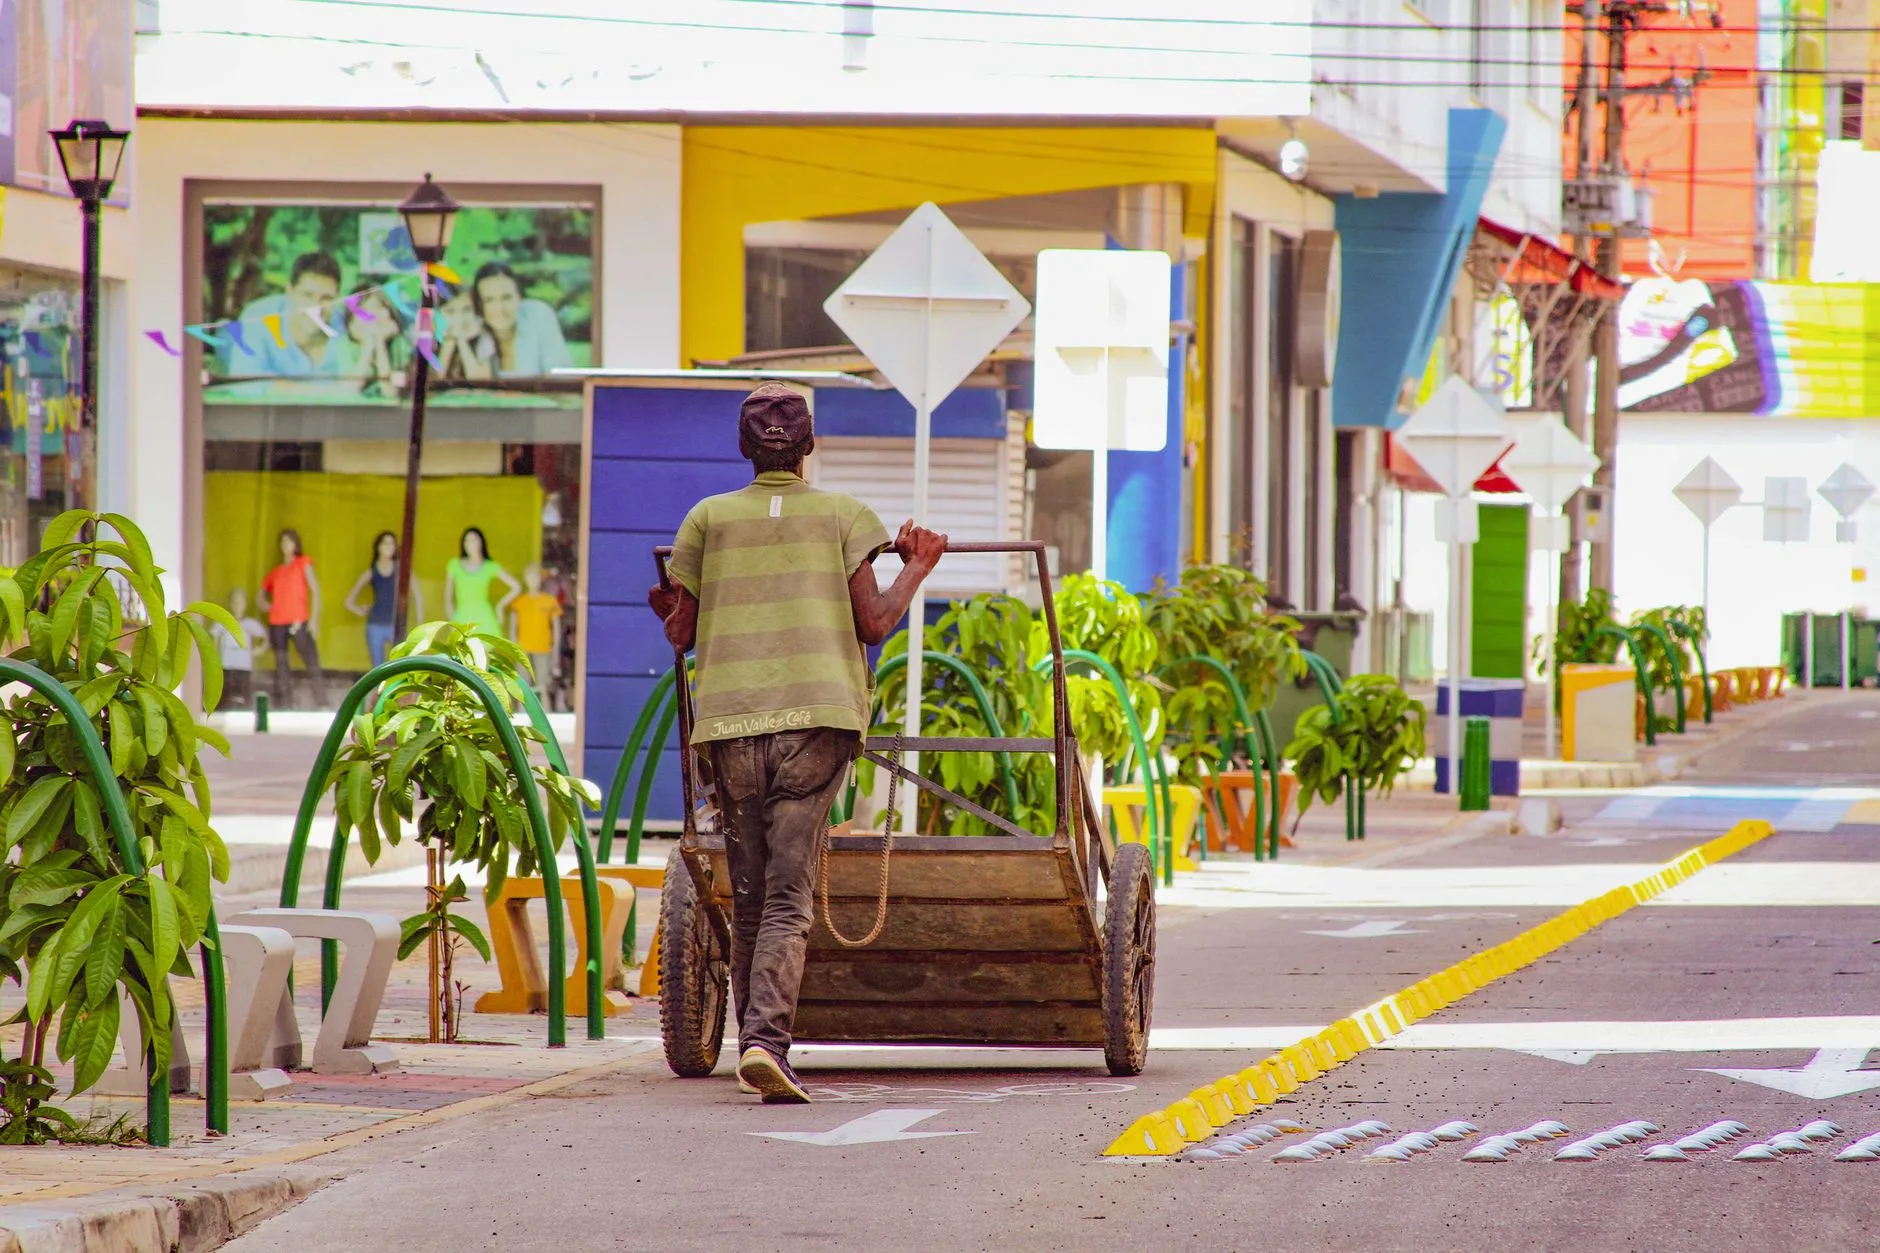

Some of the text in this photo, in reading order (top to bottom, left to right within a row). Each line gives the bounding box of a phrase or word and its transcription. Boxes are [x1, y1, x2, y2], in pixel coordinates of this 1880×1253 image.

[710, 710, 812, 737] Juan Valdez Café
